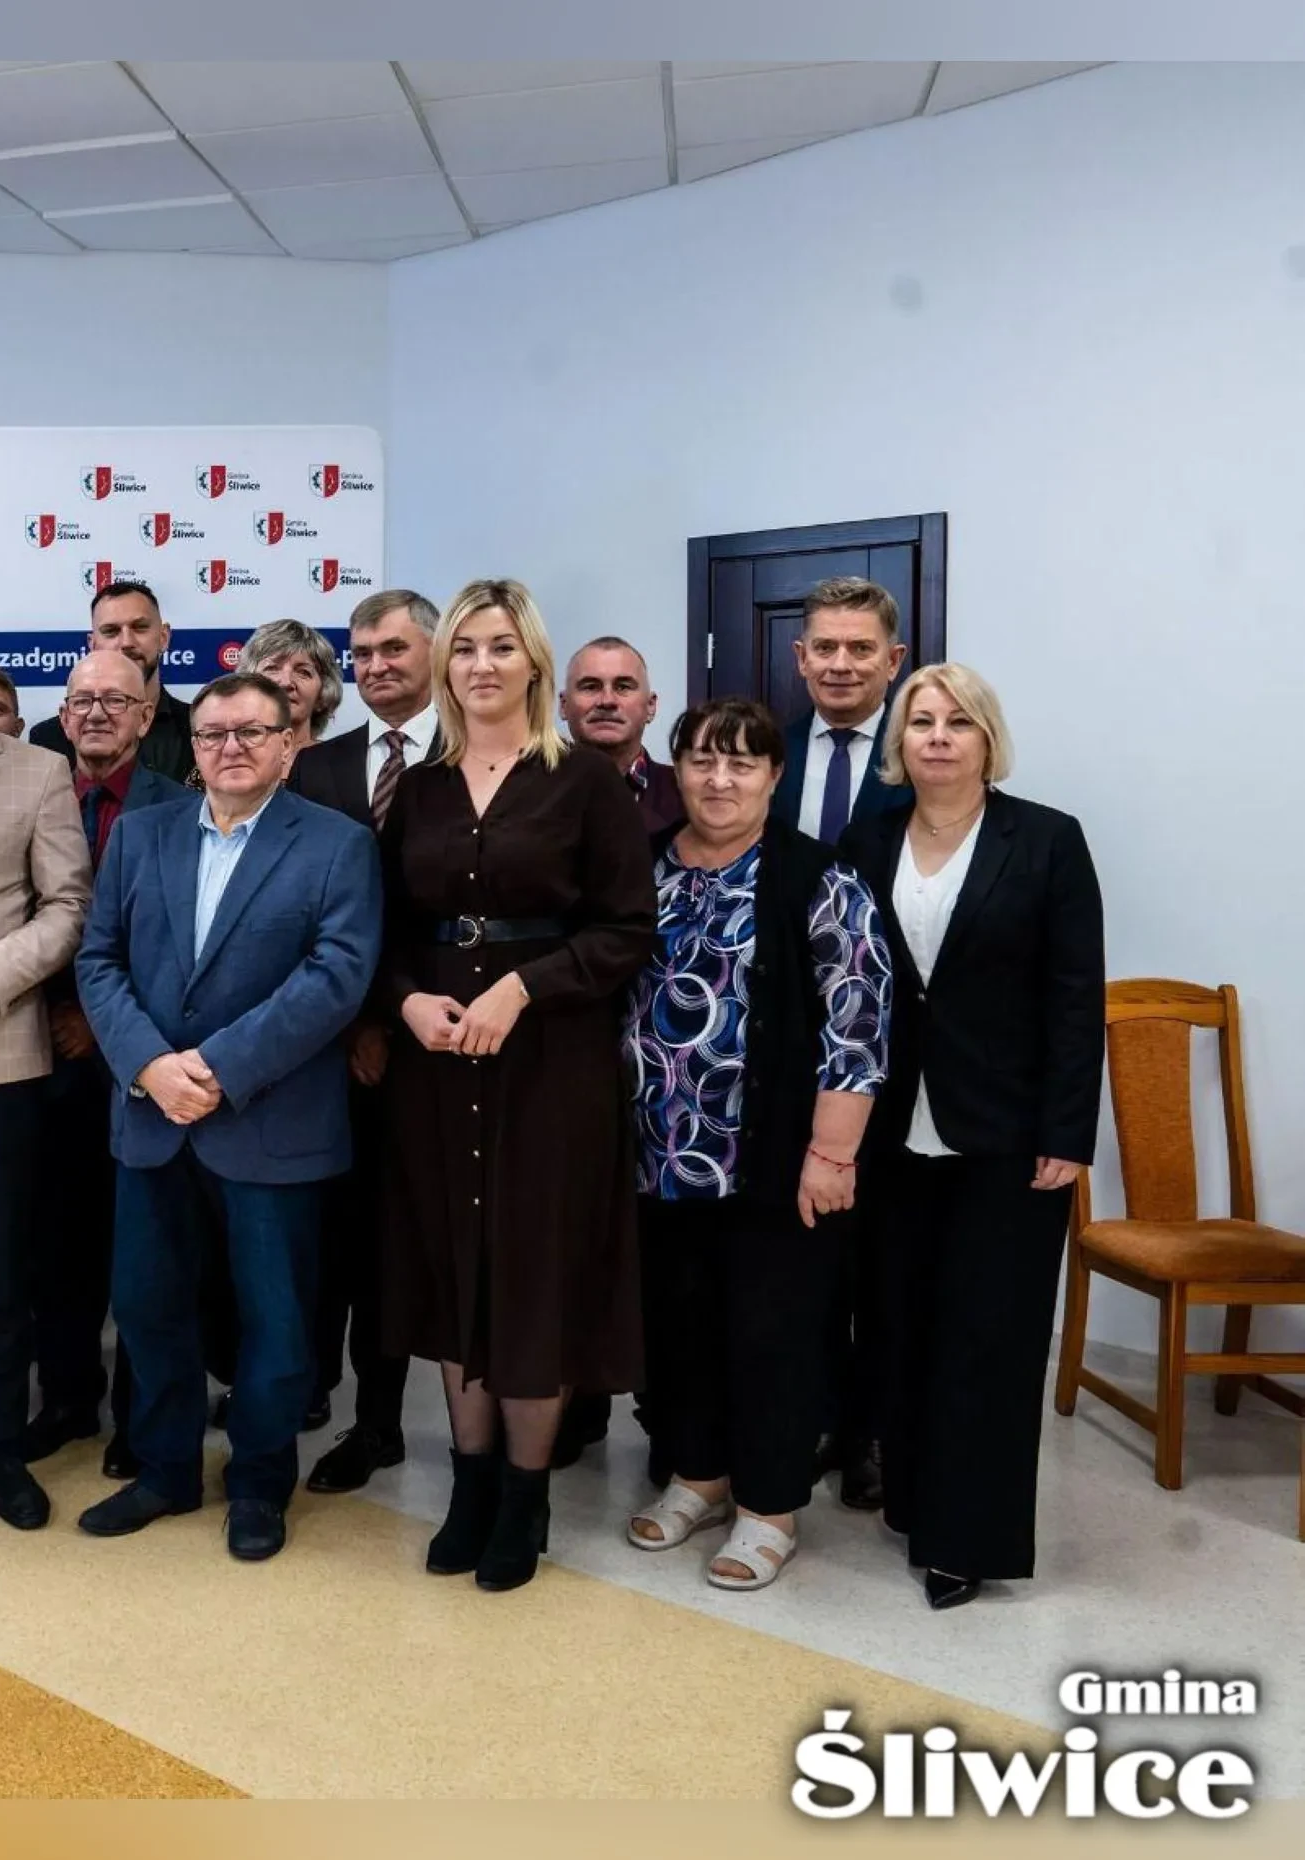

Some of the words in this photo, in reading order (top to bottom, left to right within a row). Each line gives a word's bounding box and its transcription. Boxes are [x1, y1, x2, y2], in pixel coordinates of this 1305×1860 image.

[113, 481, 147, 492] Śliwice
[227, 480, 261, 490] Śliwice
[341, 480, 375, 491] Śliwice
[57, 530, 91, 541] Śliwice
[172, 528, 205, 538] Śliwice
[285, 526, 318, 538] Śliwice
[227, 575, 261, 585] Śliwice
[340, 574, 372, 585] Śliwice
